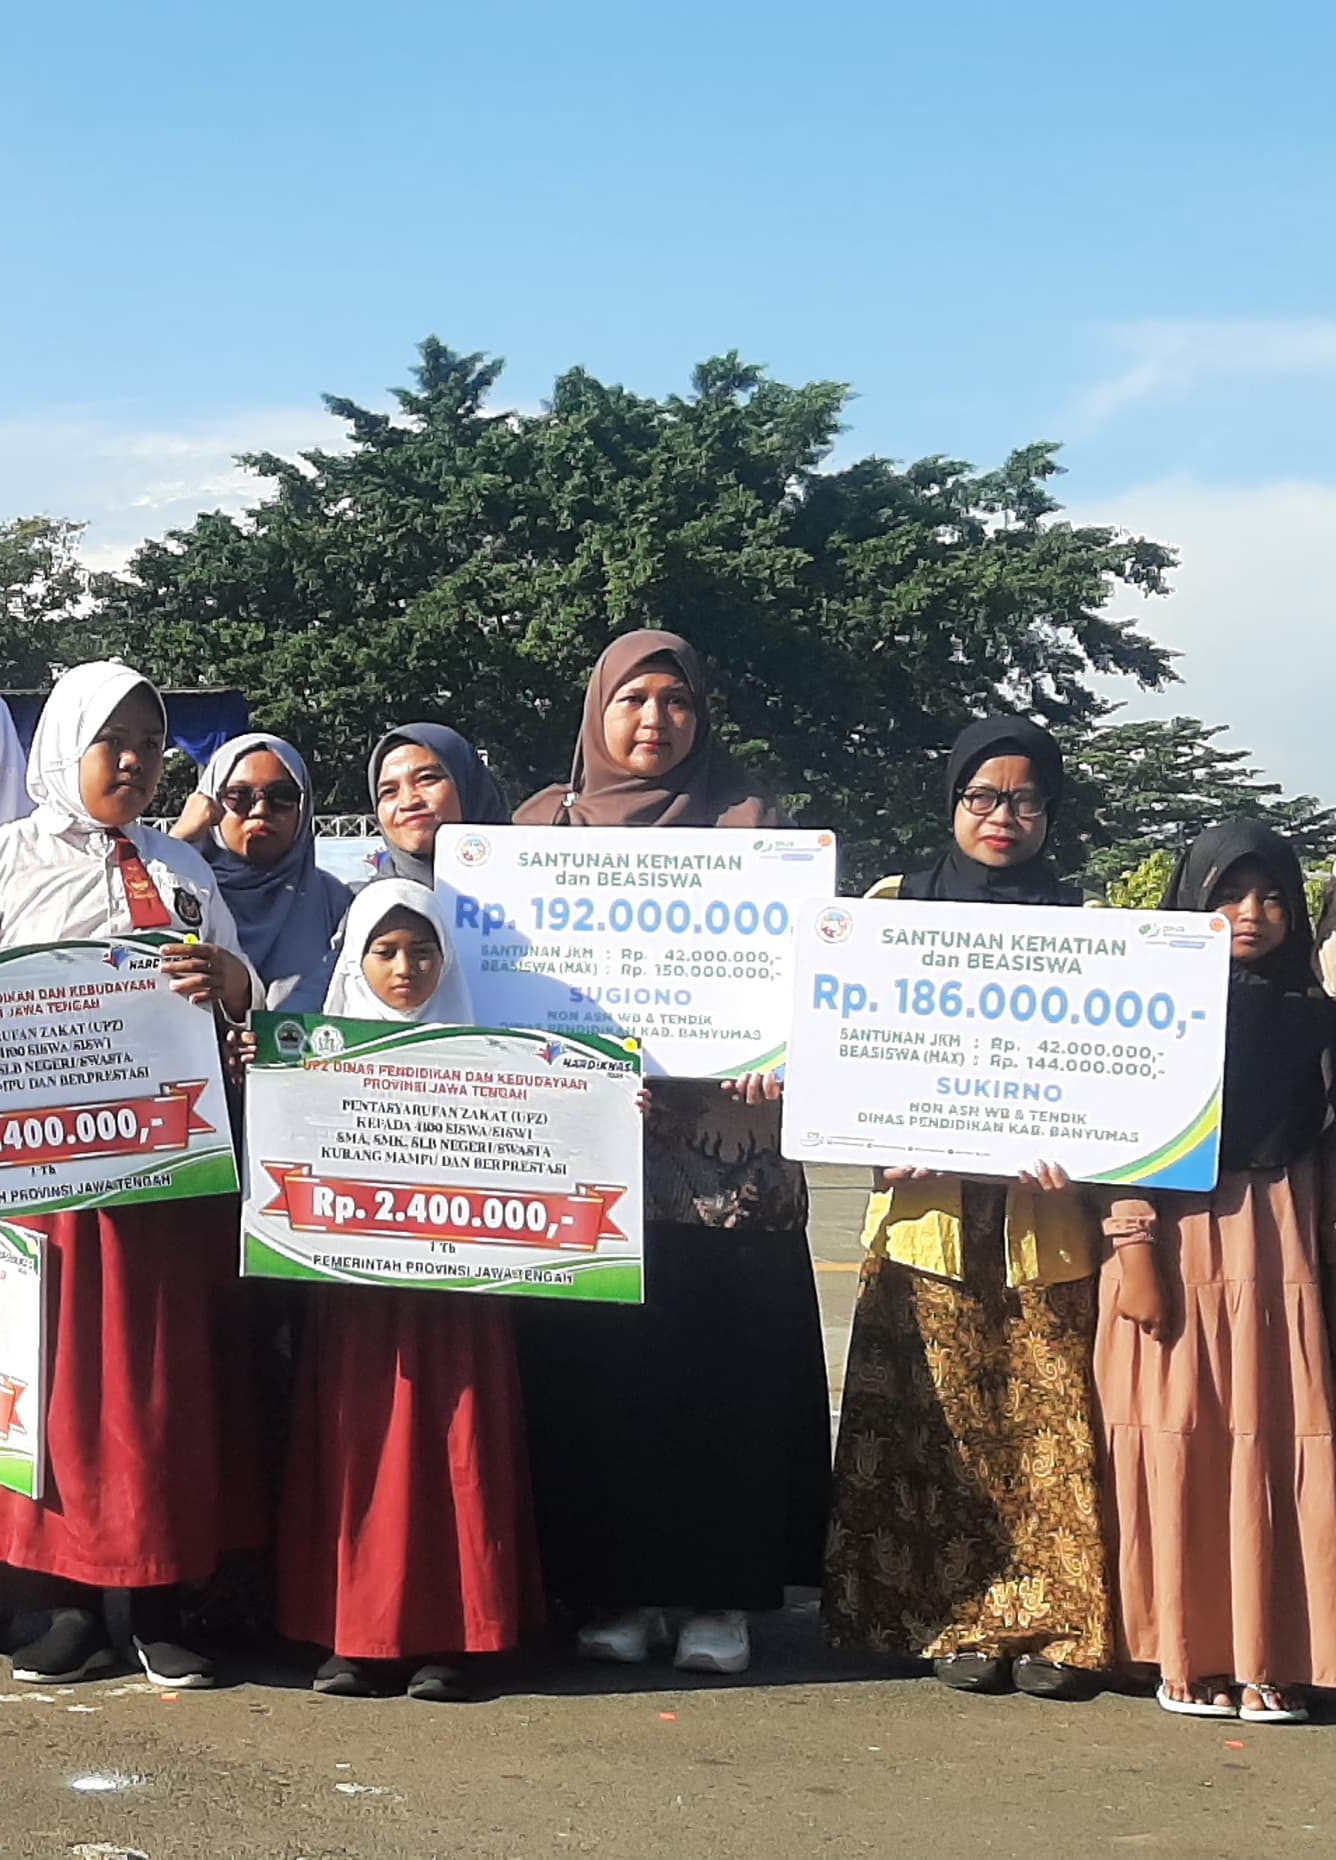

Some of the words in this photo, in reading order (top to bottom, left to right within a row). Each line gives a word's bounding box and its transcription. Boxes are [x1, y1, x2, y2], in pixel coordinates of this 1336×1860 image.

[518, 852, 630, 869] SANTUNAN
[637, 854, 742, 871] KEMATIAN
[555, 870, 590, 886] dan
[597, 872, 703, 888] BEASISWA
[455, 894, 516, 936] Rp.
[530, 896, 793, 936] 192.000.000
[881, 928, 1003, 950] SANTUNAN
[1011, 934, 1127, 956] KEMATIAN
[481, 944, 561, 958] SANTUNAN
[564, 947, 593, 959] JKM
[621, 948, 647, 963] Rp.
[664, 950, 782, 966] 42.000.000,-
[921, 950, 960, 968] dan
[967, 953, 1083, 975] BEASISWA
[480, 960, 556, 973] BEASISWA
[560, 962, 597, 976] (MAX)
[621, 964, 647, 978] Rp.
[655, 964, 782, 981] 150.000.000,-
[38, 986, 65, 1001] DAN
[69, 978, 157, 998] KEBUDAYAAN
[569, 986, 692, 1006] SUGIONO
[8, 1001, 44, 1017] JAWA
[47, 998, 101, 1014] TENGAH
[813, 973, 878, 1019] Rp.
[894, 977, 1206, 1039] 186.000.000,-
[39, 1021, 88, 1038] ZAKAT
[88, 1018, 124, 1035] (UPZ)
[840, 1027, 925, 1045] SANTUNAN
[929, 1033, 961, 1047] JKM
[990, 1036, 1021, 1053] Rp.
[1037, 1039, 1164, 1063] 42.000.000,-
[839, 1044, 920, 1061] BEASISWA
[923, 1049, 966, 1067] (MAX)
[989, 1054, 1018, 1070] Rp.
[1026, 1056, 1166, 1080] 144.000.000,-
[29, 1076, 57, 1090] DAN
[60, 1066, 150, 1086] BERPRESTASI
[304, 1060, 329, 1072] UPZ
[333, 1060, 375, 1075] DINAS
[378, 1064, 462, 1081] PENDIDIKAN
[465, 1071, 494, 1083] DAN
[497, 1072, 589, 1092] KEBUDAYAAN
[363, 1077, 427, 1093] PROVINSI
[428, 1080, 468, 1096] JAWA
[472, 1085, 528, 1101] TENGAH
[936, 1076, 1063, 1102] SUKIRNO
[342, 1099, 457, 1118] PENTASYARUFAN
[459, 1106, 507, 1123] ZAKAT
[511, 1112, 549, 1126] (UPZ)
[356, 1116, 412, 1132] KEPADA
[909, 1102, 943, 1114] NON
[1028, 1109, 1087, 1125] TENDIK
[857, 1112, 905, 1126] DINAS
[909, 1115, 1004, 1133] PENDIDIKAN
[1009, 1122, 1045, 1136] KAB.
[1049, 1126, 1139, 1143] BANYUMAS
[411, 1138, 437, 1150] SLB
[321, 1146, 382, 1162] KURANG
[385, 1152, 439, 1166] MAMPU
[441, 1155, 470, 1169] DAN
[474, 1158, 567, 1176] BERPRESTASI
[11, 1184, 73, 1203] PROVINSI
[77, 1180, 117, 1195] JAWA
[118, 1174, 172, 1191] TENGAH
[313, 1186, 367, 1225] Rp.
[374, 1189, 575, 1239] 2.400.000,-
[313, 1254, 402, 1272] PEMERINTAH
[406, 1261, 471, 1277] PROVINSI
[474, 1266, 512, 1280] JAWA
